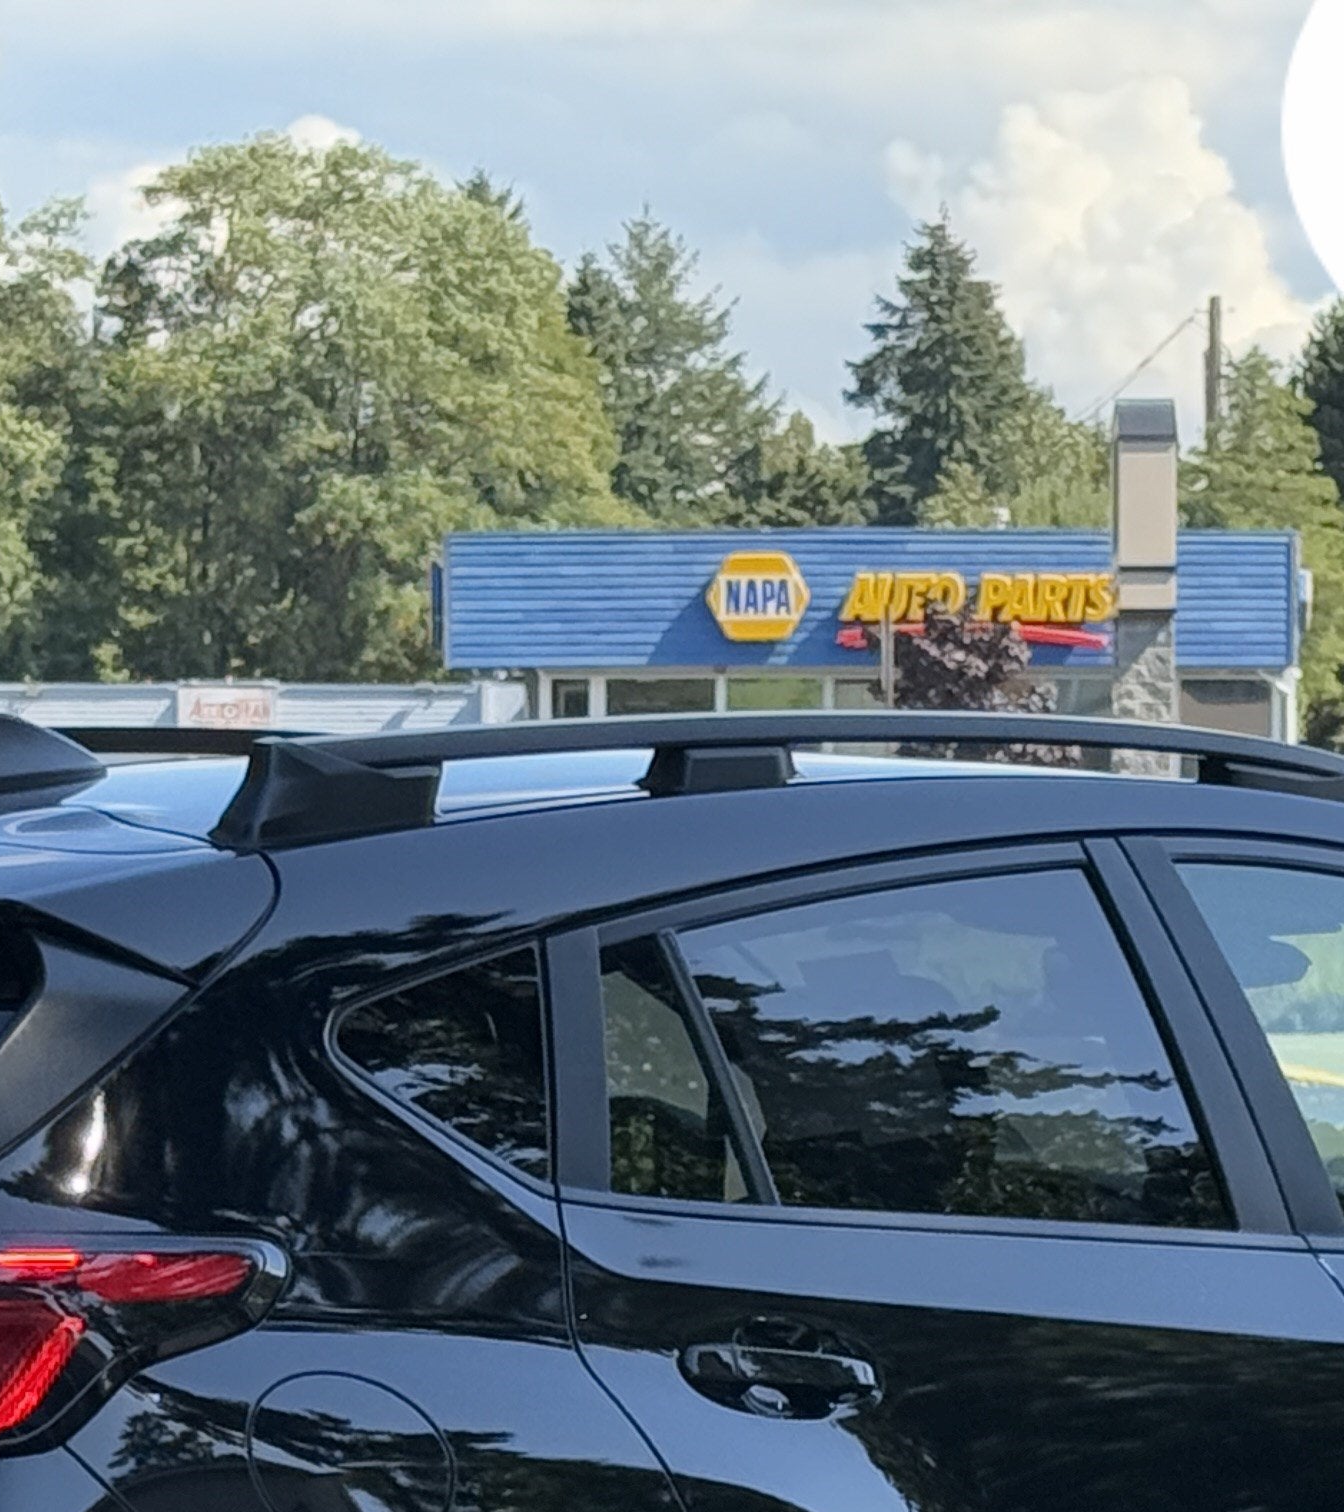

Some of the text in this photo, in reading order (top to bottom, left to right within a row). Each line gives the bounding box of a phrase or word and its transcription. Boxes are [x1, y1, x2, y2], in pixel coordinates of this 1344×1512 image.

[726, 572, 1118, 623] NAPA AUTO PARTS
